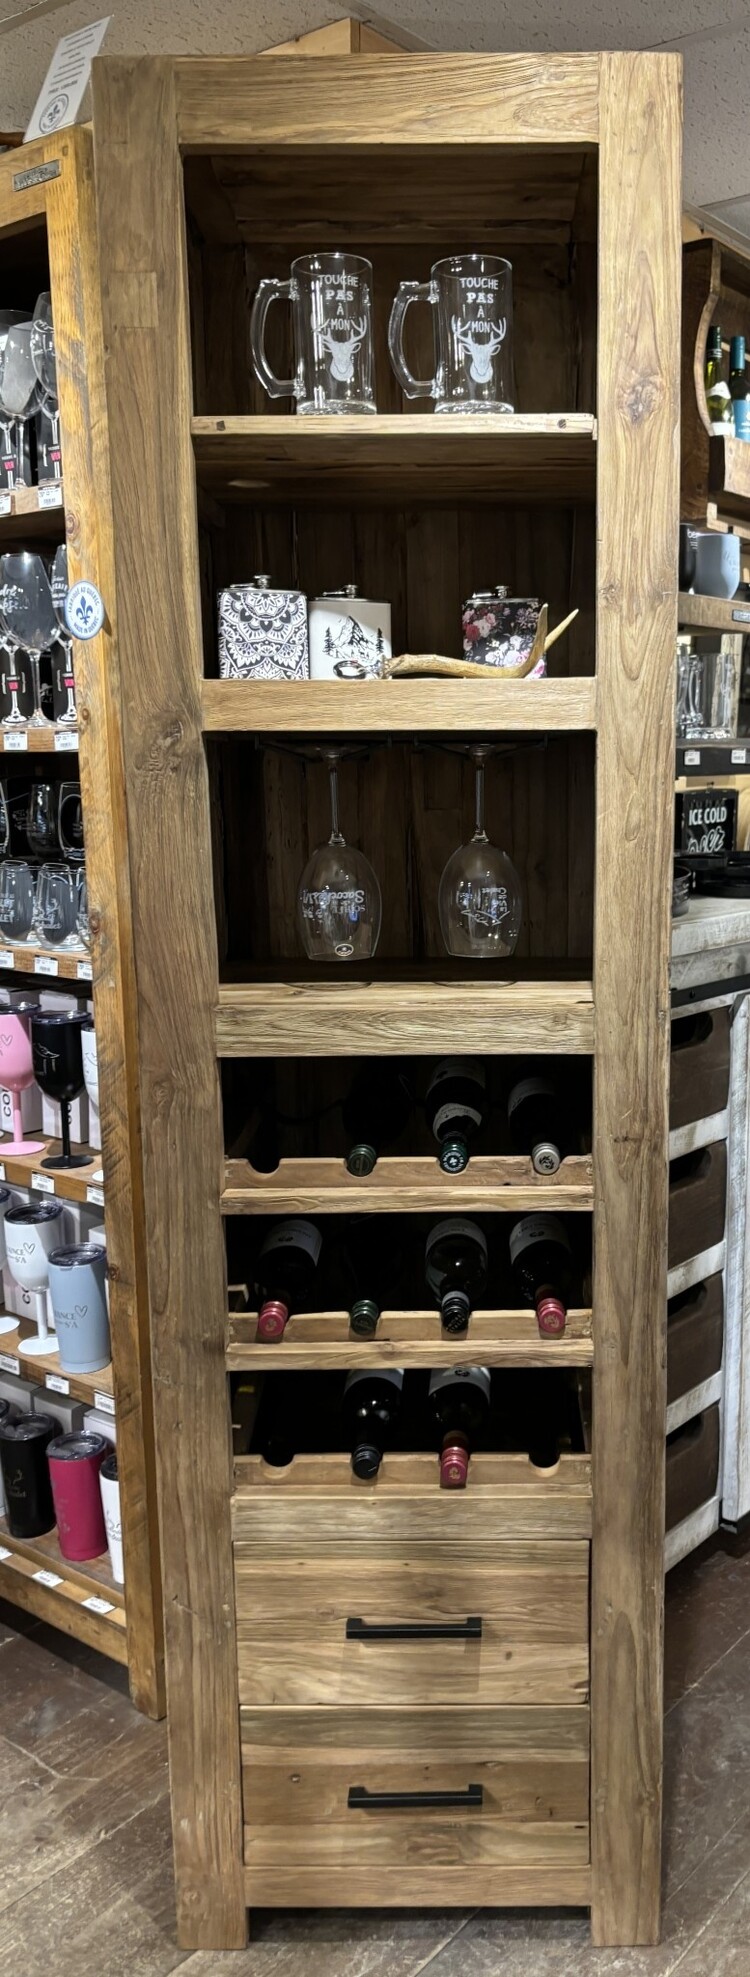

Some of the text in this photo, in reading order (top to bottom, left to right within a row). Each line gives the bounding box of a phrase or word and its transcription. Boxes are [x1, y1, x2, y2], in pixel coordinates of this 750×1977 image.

[318, 274, 359, 288] TOUCHE
[459, 277, 499, 290] TOUCHE
[325, 290, 354, 301] PAS
[466, 293, 494, 304] PAS
[336, 303, 344, 315] À
[477, 305, 485, 318] À
[330, 318, 350, 331] MON
[471, 320, 491, 333] MON
[688, 806, 727, 826] ICE COLD
